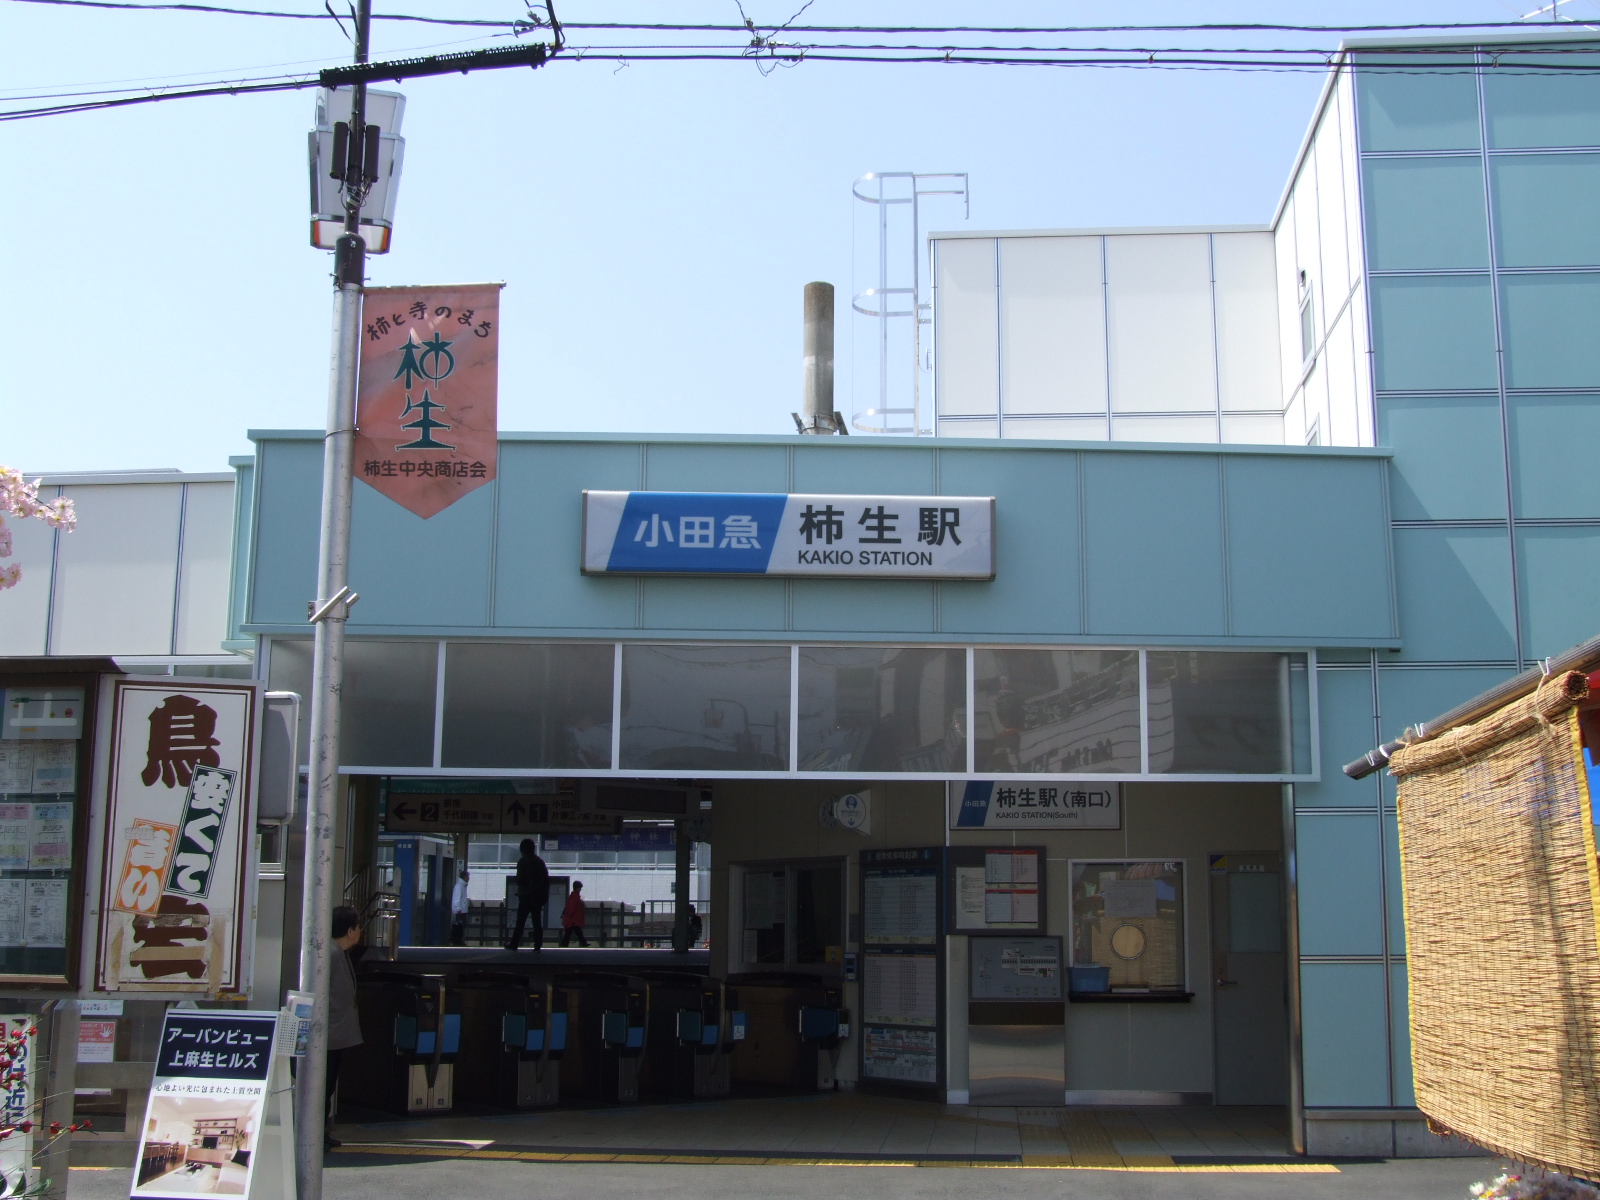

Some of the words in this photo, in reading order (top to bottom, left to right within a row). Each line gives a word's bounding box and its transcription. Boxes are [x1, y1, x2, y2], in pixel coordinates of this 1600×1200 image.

[366, 301, 492, 342] 柿と寺のまち
[393, 332, 456, 451] 柿生
[364, 460, 487, 479] 柿生中央商店会
[634, 514, 762, 549] 小田急
[799, 504, 962, 547] 柿生駅
[798, 550, 854, 566] KAKIO
[858, 551, 933, 566] STATION
[964, 800, 987, 808] 小田急
[996, 787, 1112, 808] 柿生駅(南口)
[424, 805, 436, 820] 2
[1021, 812, 1078, 820] STATION(South)
[167, 1026, 269, 1045] アーバンビュー
[169, 1050, 259, 1069] 上麻生ヒルズ
